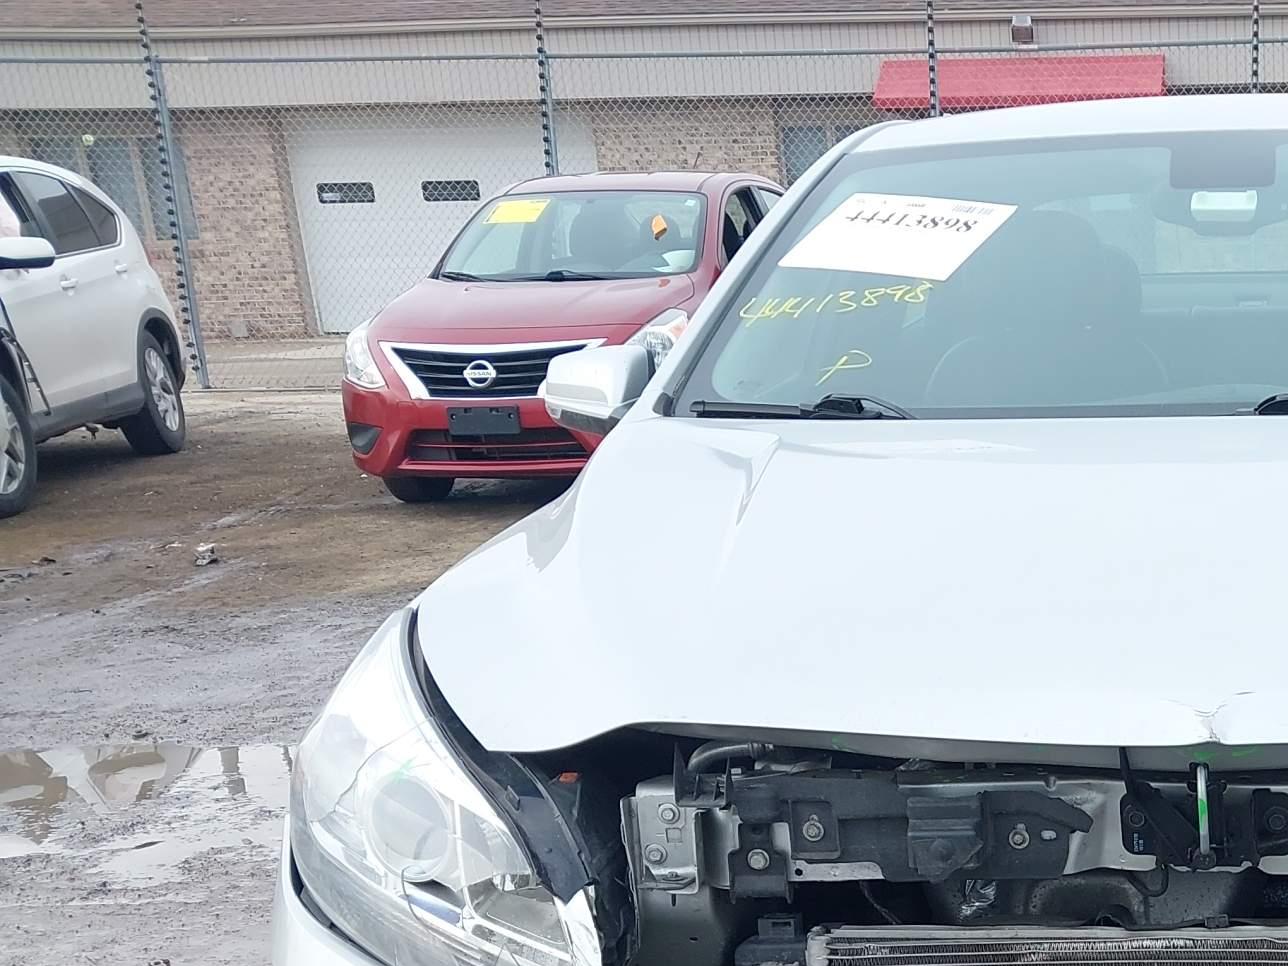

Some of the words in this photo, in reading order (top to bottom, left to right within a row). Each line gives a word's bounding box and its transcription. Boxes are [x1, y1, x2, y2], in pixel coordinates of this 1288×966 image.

[845, 210, 978, 233] 44413898
[740, 281, 933, 327] 44413898
[815, 350, 872, 386] P
